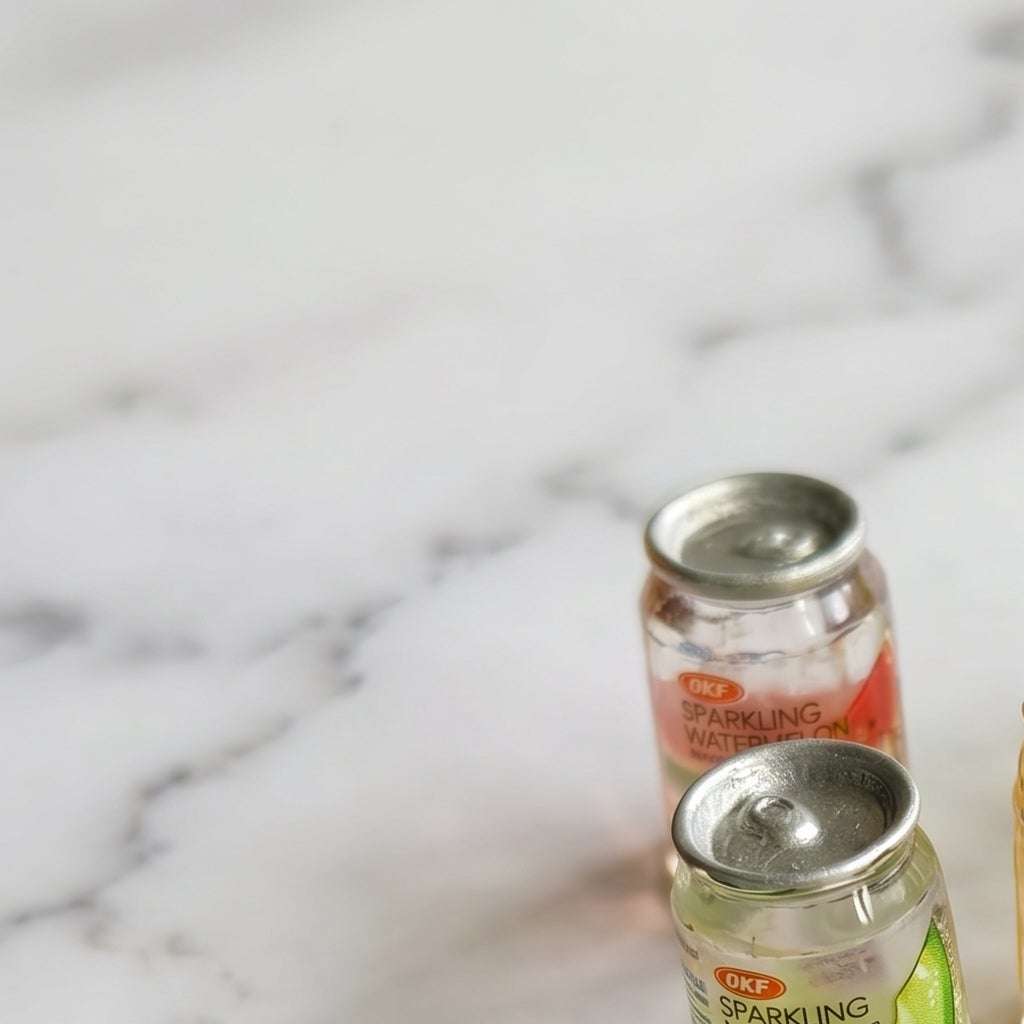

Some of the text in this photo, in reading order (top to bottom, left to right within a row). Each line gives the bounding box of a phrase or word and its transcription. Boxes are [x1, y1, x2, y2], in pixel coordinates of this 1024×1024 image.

[689, 680, 729, 698] OKF
[681, 700, 822, 731] SPARKLING
[726, 973, 770, 995] OKF
